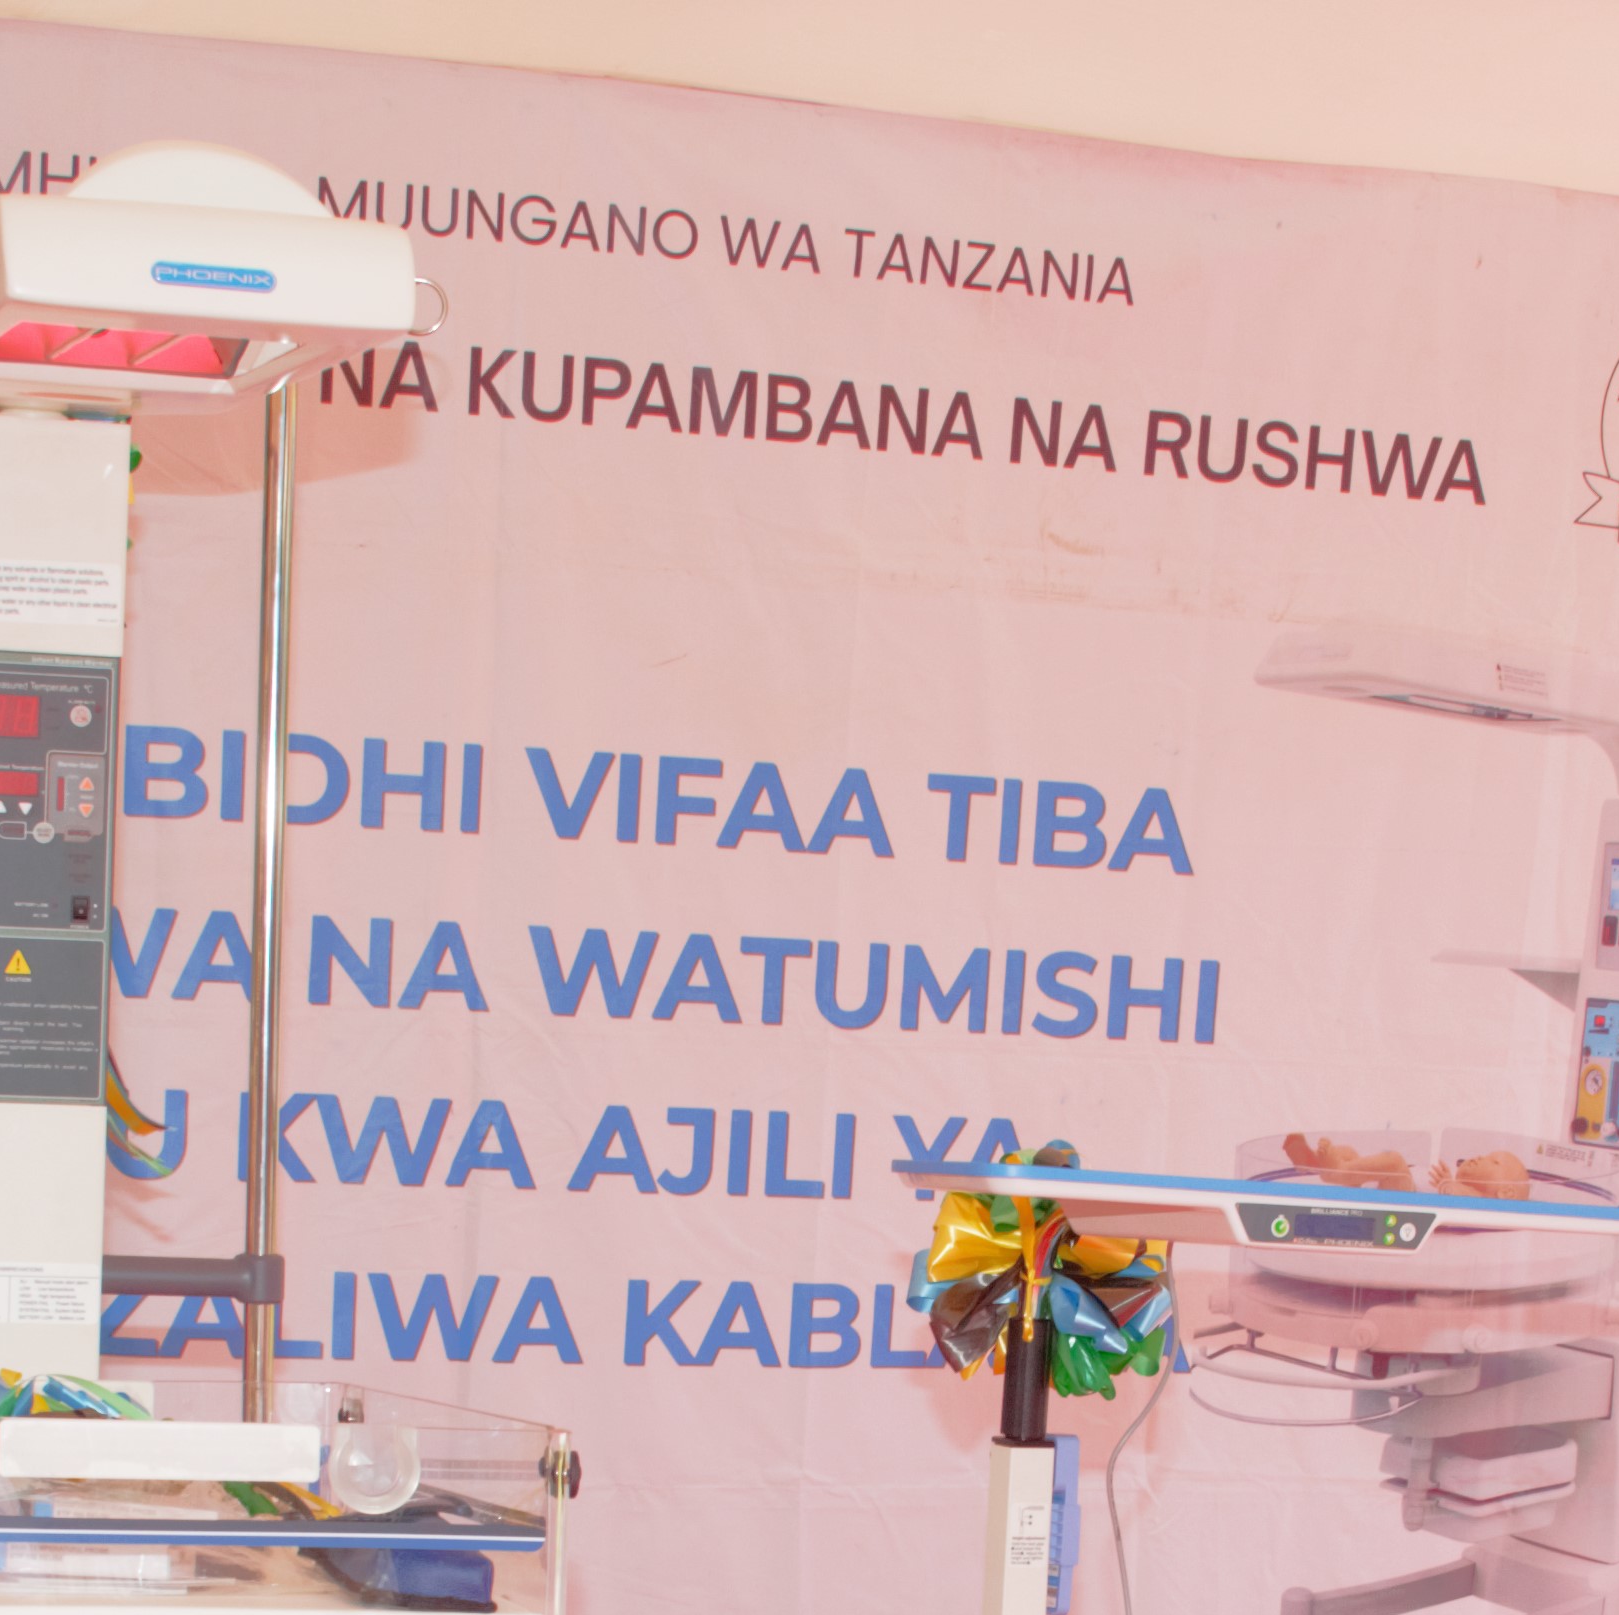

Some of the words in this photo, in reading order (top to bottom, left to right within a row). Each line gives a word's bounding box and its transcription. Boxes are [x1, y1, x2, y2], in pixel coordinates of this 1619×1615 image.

[154, 265, 272, 288] PHOENIX
[318, 176, 699, 260] MUUNGANO
[720, 214, 821, 276] WA
[844, 228, 1135, 307] TANZANIA
[320, 343, 439, 413] NA
[467, 346, 984, 461] KUPAMBANA
[1009, 397, 1117, 473] NA
[1143, 410, 1487, 506] RUSHWA
[525, 747, 893, 858] VIFAA
[928, 773, 1193, 875] TIBA
[308, 915, 488, 1011] NA
[528, 925, 1219, 1044] WATUMISHI
[237, 1092, 535, 1190] KWA
[567, 1104, 856, 1199] AJILI
[624, 1277, 953, 1369] KABL
